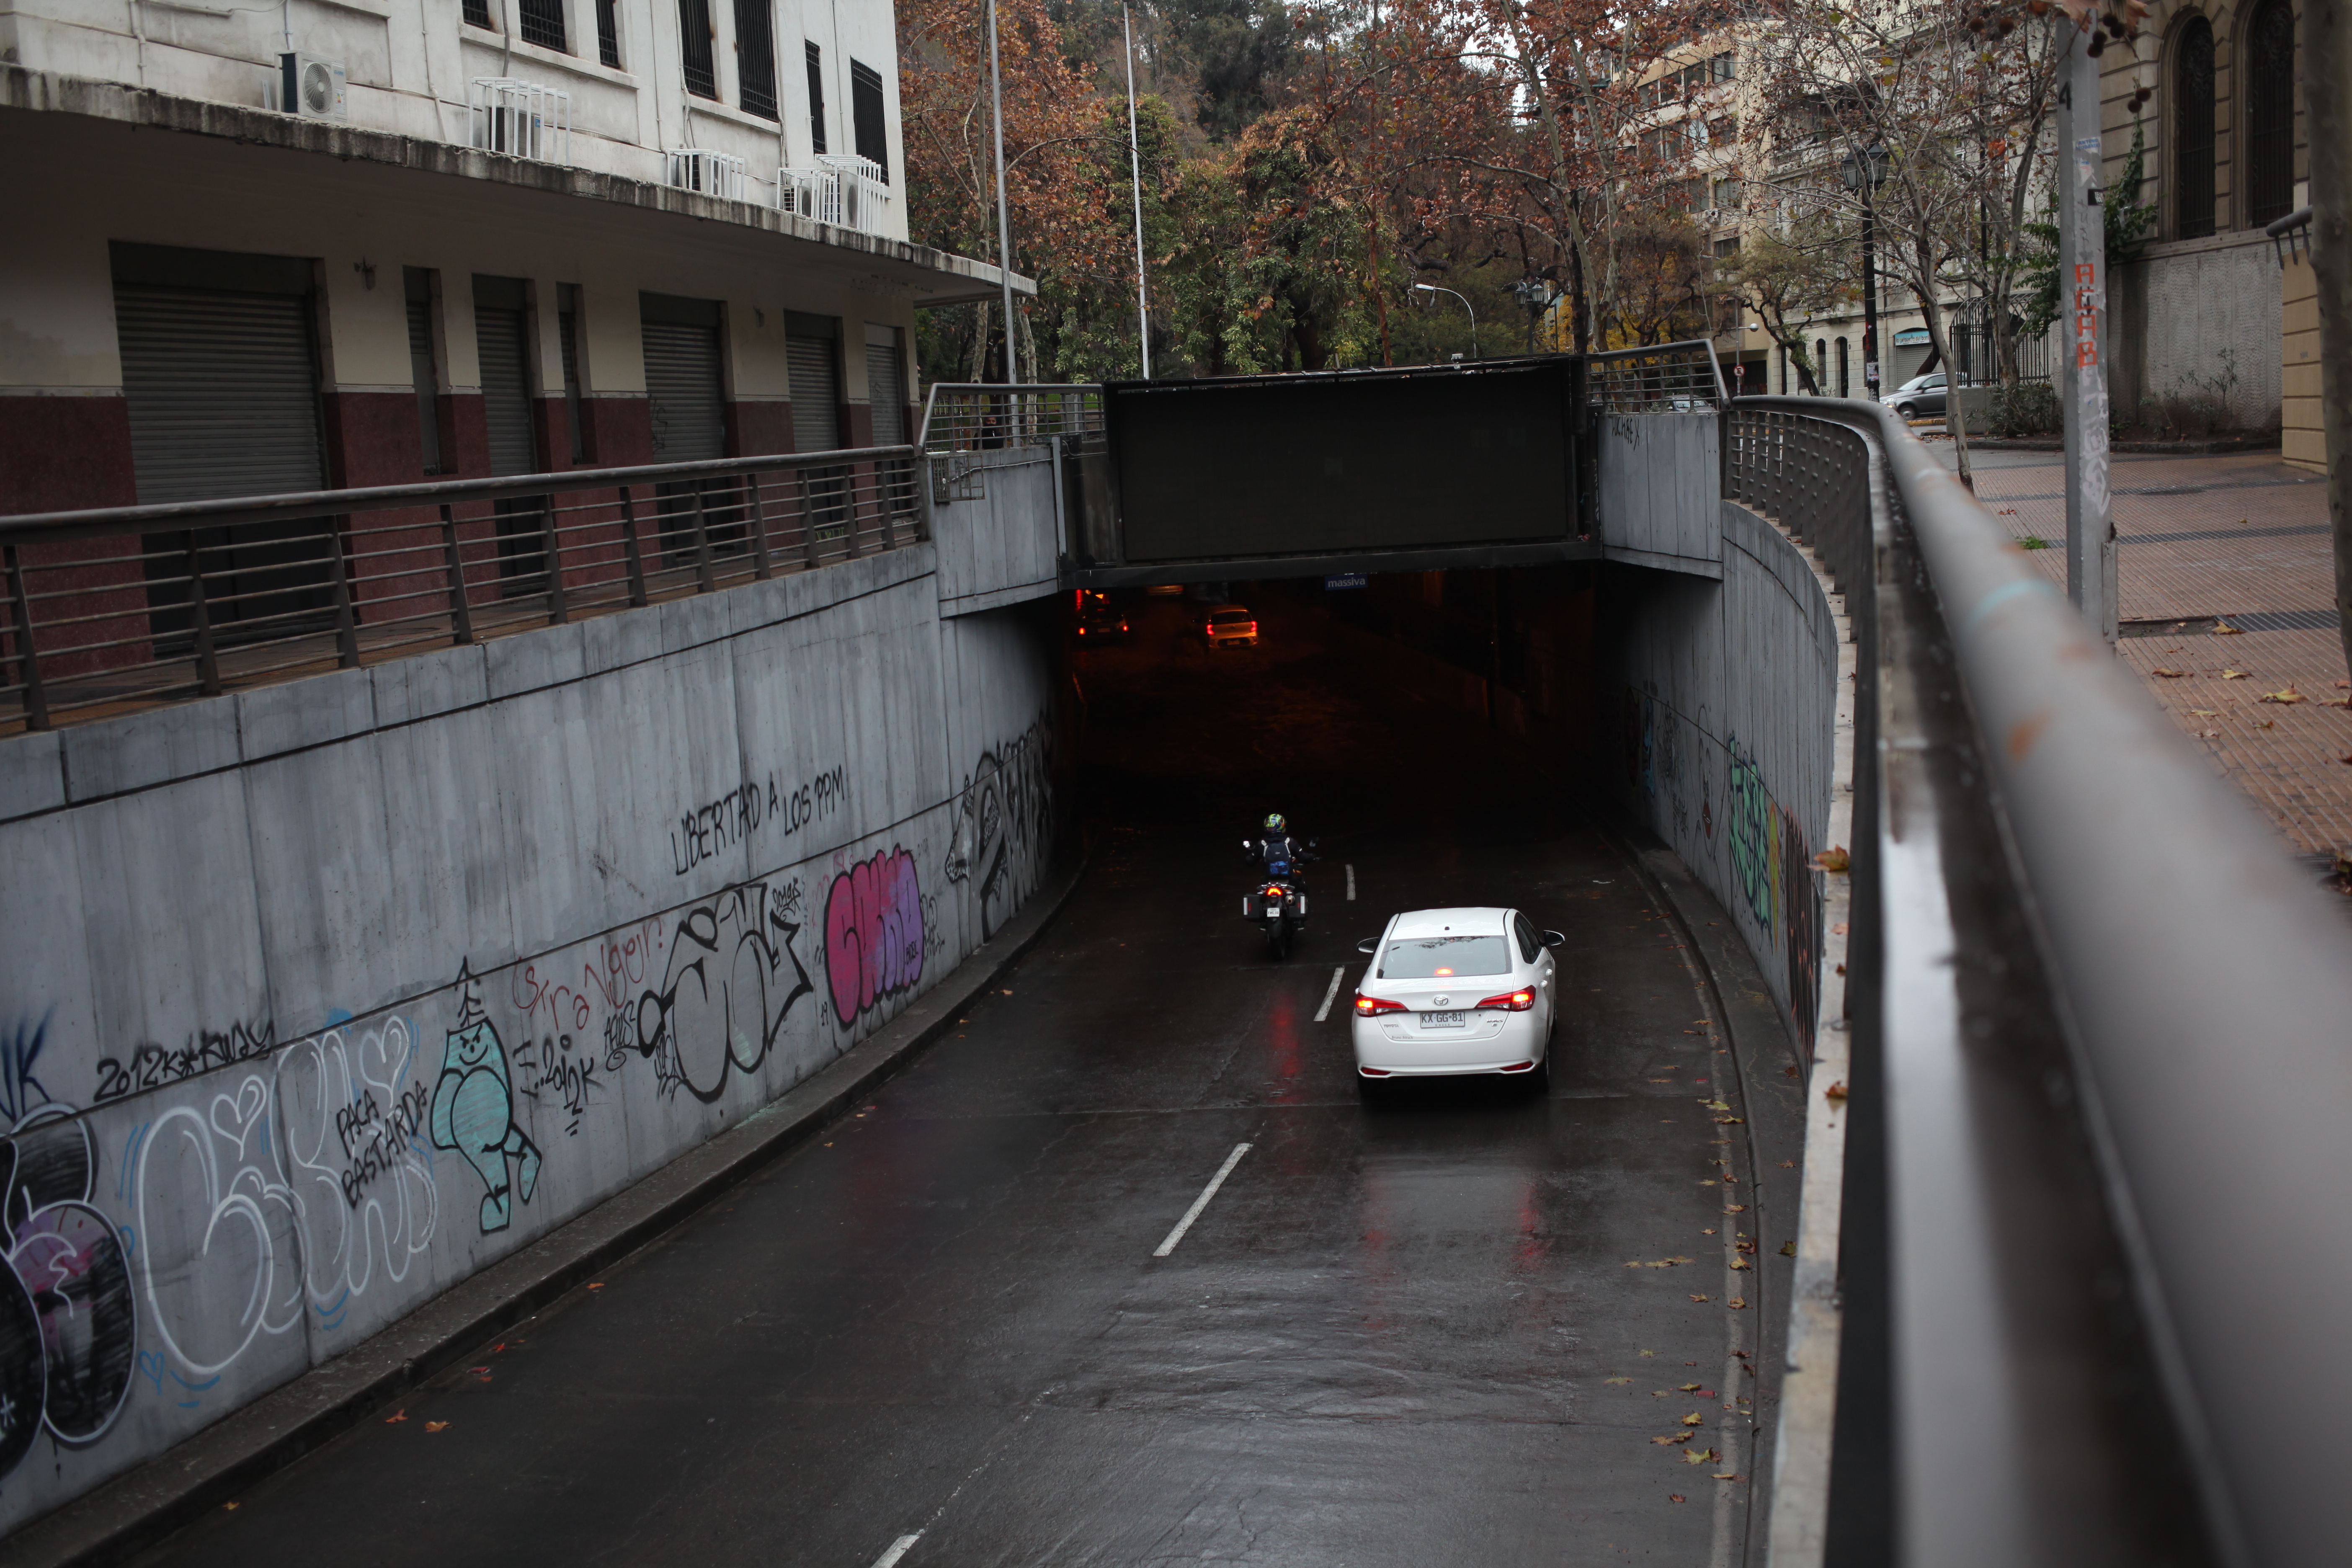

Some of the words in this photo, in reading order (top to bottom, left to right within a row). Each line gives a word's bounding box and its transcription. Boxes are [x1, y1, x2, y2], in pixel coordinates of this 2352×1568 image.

[2076, 263, 2098, 368] ACAB
[1328, 578, 1365, 588] massiva
[769, 771, 779, 820] A
[784, 785, 811, 836] LOS
[336, 1089, 379, 1159] PACA
[341, 1081, 427, 1209] BASTARDA
